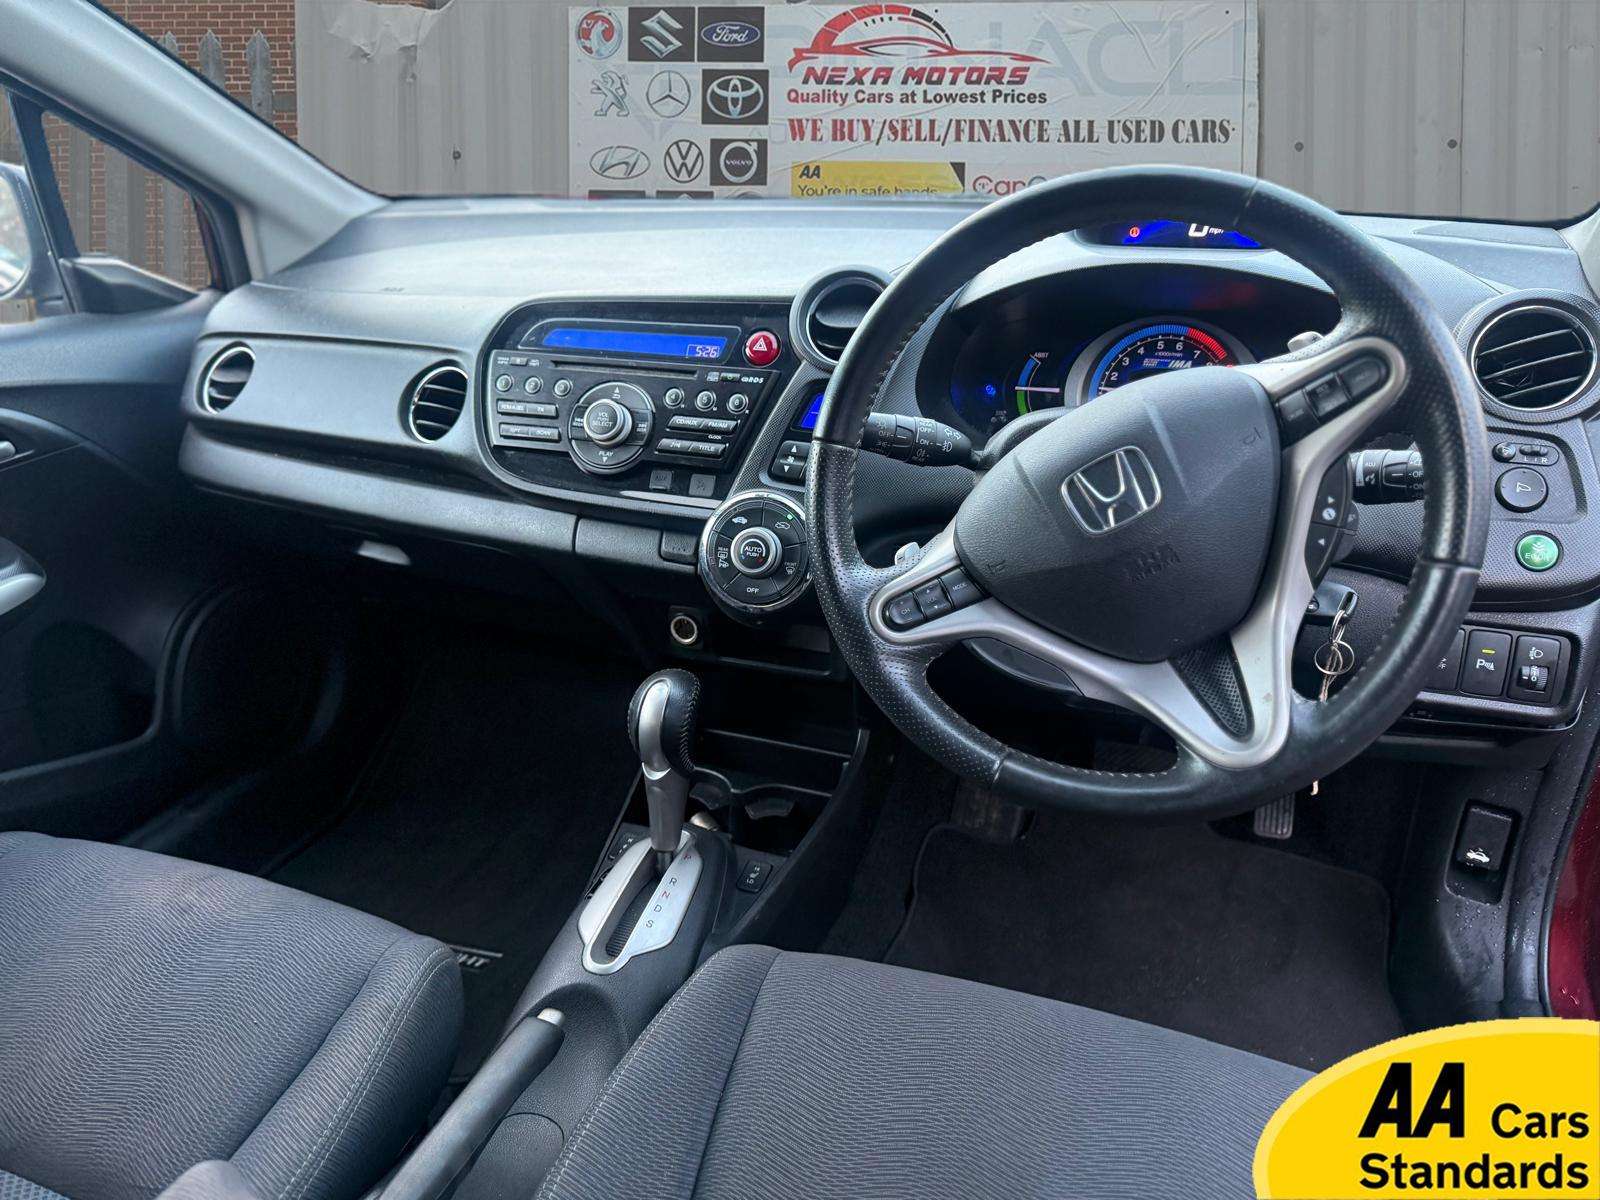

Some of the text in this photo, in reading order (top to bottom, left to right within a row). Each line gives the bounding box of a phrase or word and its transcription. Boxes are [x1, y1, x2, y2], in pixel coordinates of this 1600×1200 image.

[711, 23, 749, 42] Ford
[802, 66, 1030, 85] NEXA MOTORS
[787, 88, 1047, 106] Quality Cars at Lowest Prices
[788, 118, 1232, 146] WE BUY/SELL/FINANCE ALL USED CARS
[799, 164, 821, 179] AA
[798, 184, 841, 197] You're
[845, 186, 858, 196] in
[861, 184, 890, 195] safe
[695, 345, 717, 358] 5:26
[1168, 359, 1192, 369] IMA
